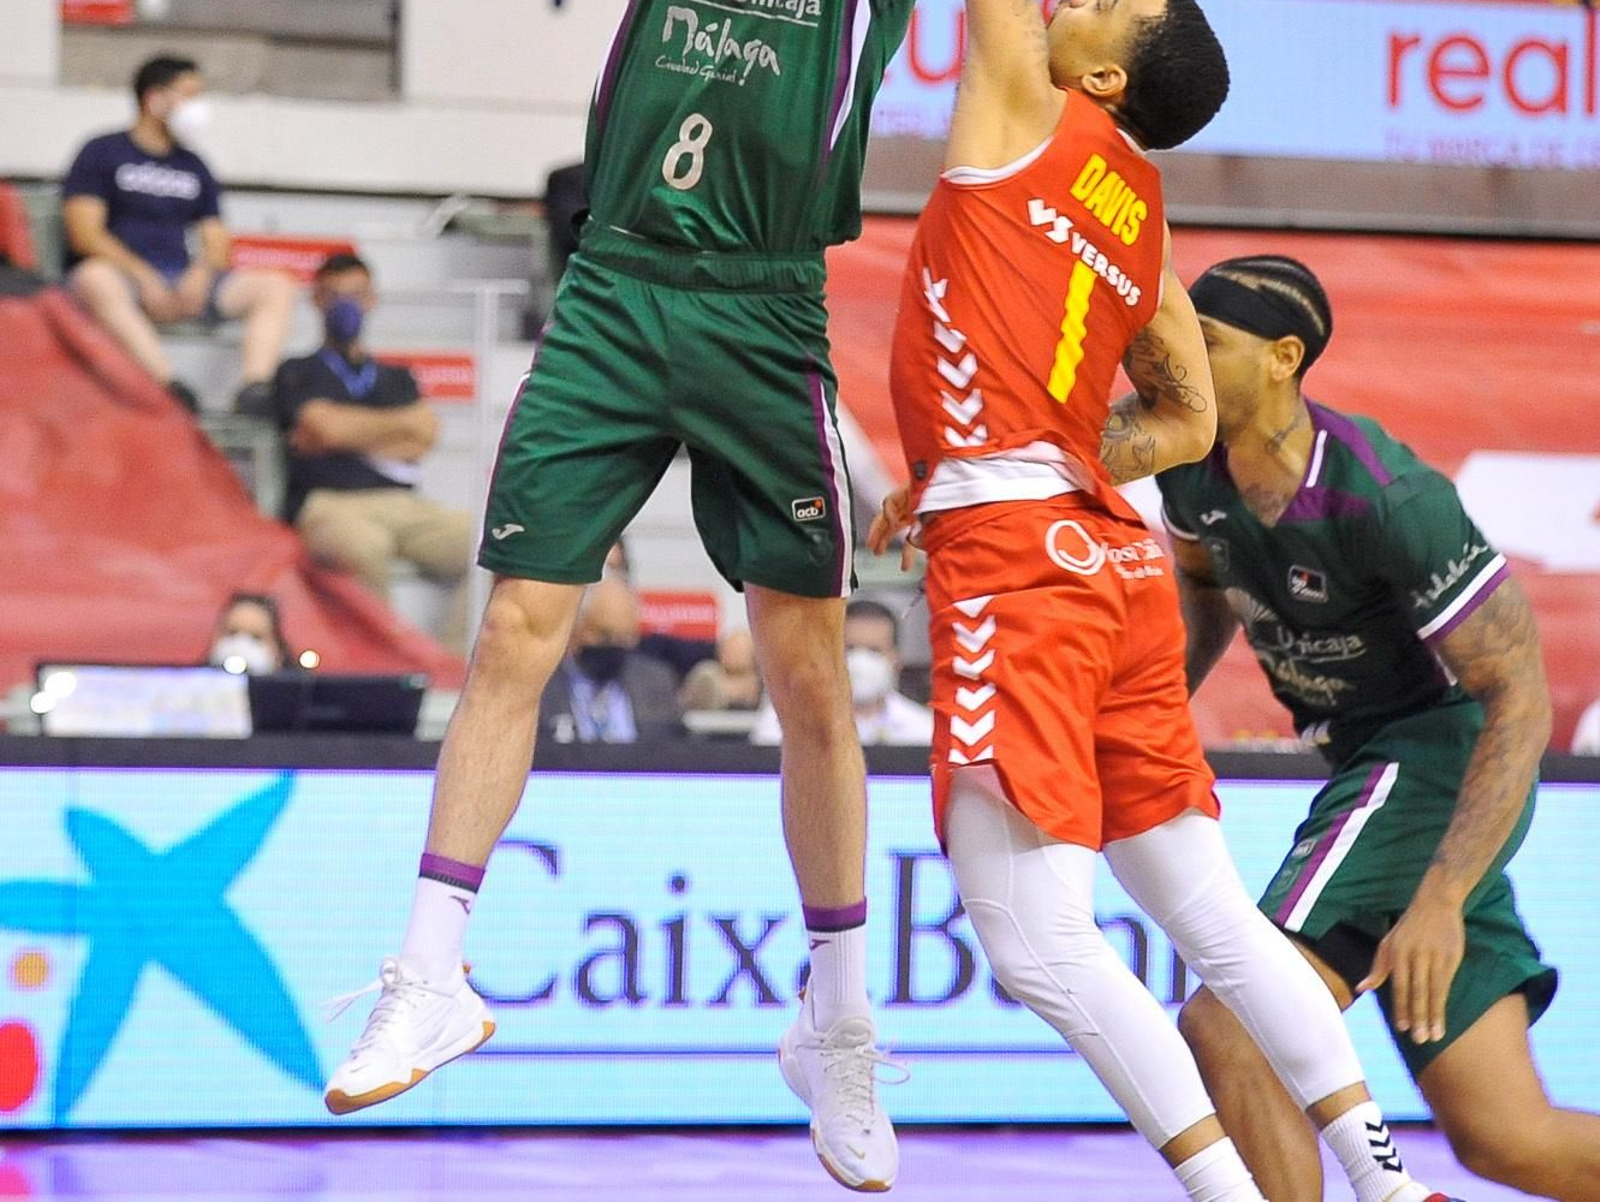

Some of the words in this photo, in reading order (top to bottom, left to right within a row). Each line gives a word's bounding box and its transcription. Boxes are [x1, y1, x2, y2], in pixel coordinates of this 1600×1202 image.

[662, 5, 780, 86] Málaga
[661, 113, 713, 190] 8
[1069, 152, 1148, 246] DAVIS
[1071, 231, 1142, 307] VERSUS
[1047, 258, 1099, 404] 1
[797, 506, 819, 518] acb
